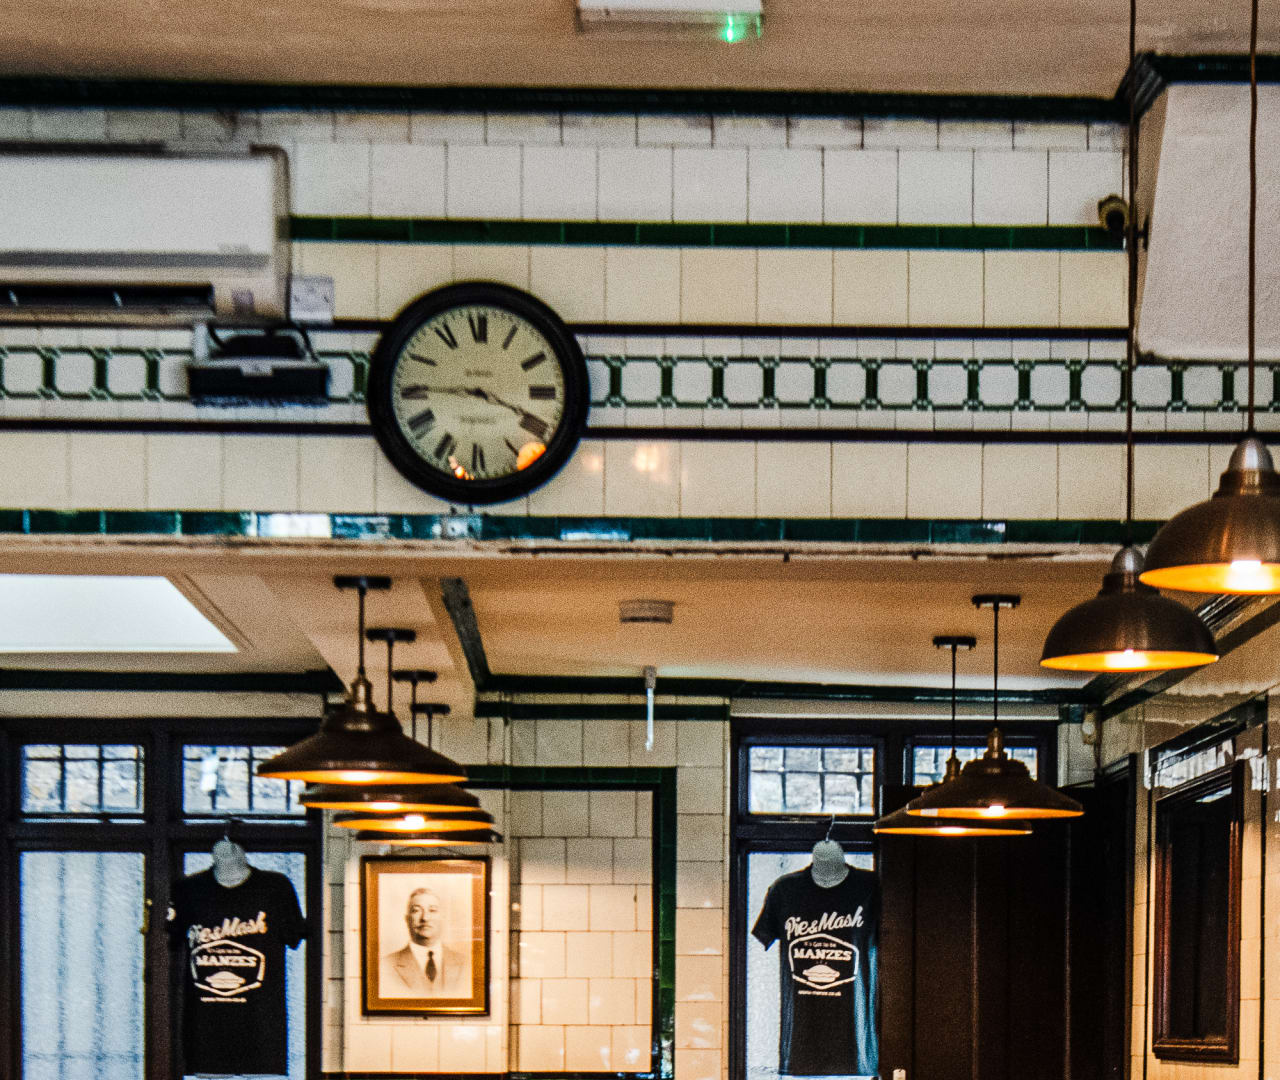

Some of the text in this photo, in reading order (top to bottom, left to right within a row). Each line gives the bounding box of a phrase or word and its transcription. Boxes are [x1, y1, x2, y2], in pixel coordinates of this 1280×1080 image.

[784, 905, 864, 941] Pie&Mash
[195, 955, 257, 967] MANZES
[793, 948, 853, 961] MANZES
